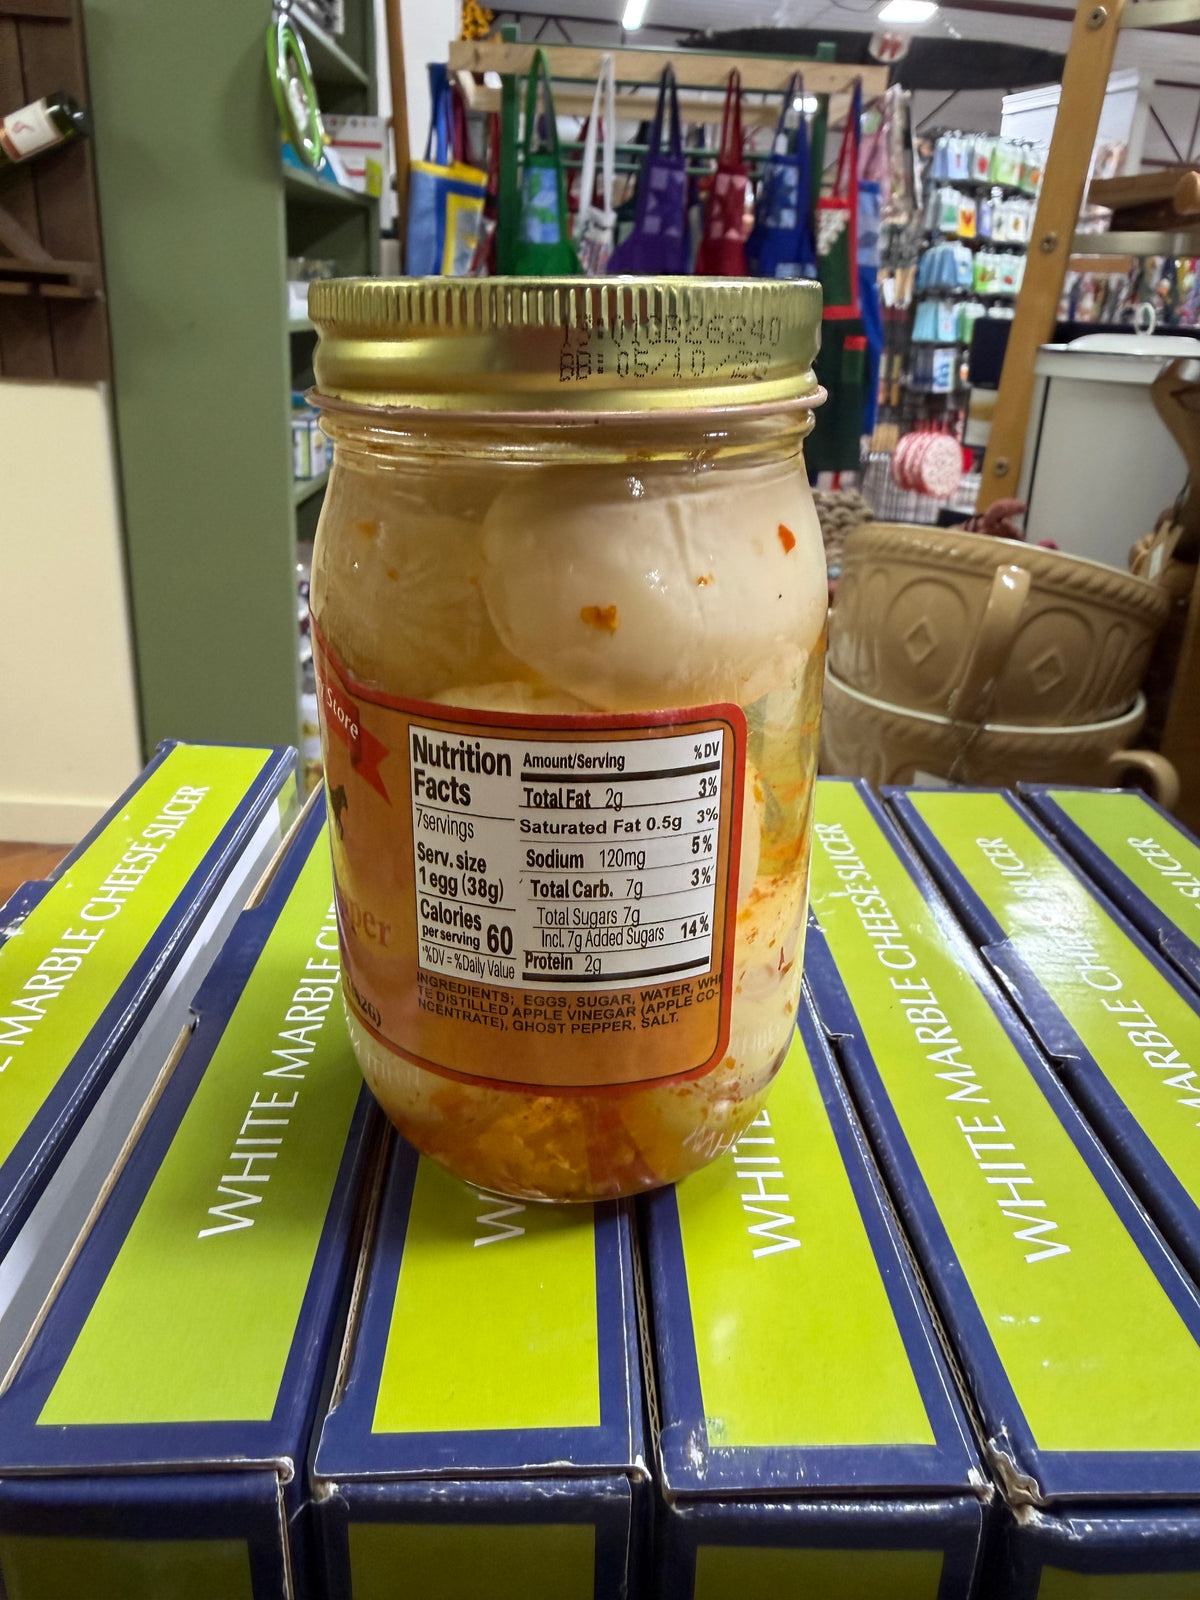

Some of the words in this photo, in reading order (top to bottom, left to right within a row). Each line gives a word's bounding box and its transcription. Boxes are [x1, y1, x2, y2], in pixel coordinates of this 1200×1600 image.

[327, 687, 359, 740] Store
[412, 733, 512, 777] Nutrition
[523, 752, 625, 772] Amount/Serving
[414, 768, 472, 806] Facts
[524, 787, 562, 809] Total
[566, 788, 591, 809] Fat
[605, 788, 623, 811] 2g
[698, 775, 718, 798] 3%
[520, 819, 607, 836] Saturated
[613, 817, 641, 834] Fat
[646, 815, 682, 832] 0.5g
[696, 806, 718, 825] 3%
[417, 841, 453, 869] Serv.
[456, 850, 487, 874] size
[526, 849, 584, 869] Sodium
[599, 849, 646, 870] 120mg
[814, 823, 872, 885] SLICER
[1127, 837, 1200, 898] SLICER
[419, 867, 427, 885] 1
[429, 873, 458, 897] egg
[462, 873, 504, 904] (38g)
[530, 879, 569, 899] Total
[572, 878, 614, 899] Carb.
[626, 878, 643, 900] 7g
[690, 867, 712, 888] 3%
[0, 927, 105, 1046] MARBLE
[81, 833, 166, 923] CHEESE
[144, 785, 210, 841] SLICER
[420, 898, 482, 932] Calories
[537, 907, 571, 926] Total
[573, 906, 618, 929] Sugars
[623, 906, 641, 927] 7g
[849, 884, 917, 970] CHEESE
[422, 924, 439, 943] per
[440, 929, 480, 951] serving
[487, 924, 513, 956] 60
[541, 929, 565, 949] Incl.
[567, 929, 583, 952] 7g
[585, 928, 624, 948] Added
[626, 924, 665, 948] Sugars
[454, 952, 486, 979] %Daily
[487, 959, 515, 980] Value
[524, 951, 573, 972] Protein
[584, 955, 602, 975] 2g
[417, 985, 433, 1000] TE
[436, 991, 509, 1016] DISTILLED
[512, 1007, 562, 1021] APPLE
[567, 1006, 637, 1021] VINEGAR
[641, 999, 693, 1020] (APPLE
[696, 988, 719, 1003] CO-
[523, 995, 572, 1010] EGGS,
[577, 993, 636, 1009] SUGAR,
[640, 984, 694, 1003] WATER,
[513, 1019, 566, 1035] GHOST
[641, 1012, 679, 1030] SALT.
[894, 976, 990, 1104] MARBLE
[198, 1091, 299, 1239] WHITE
[263, 957, 341, 1079] MARBLE
[956, 1114, 1071, 1264] WHITE
